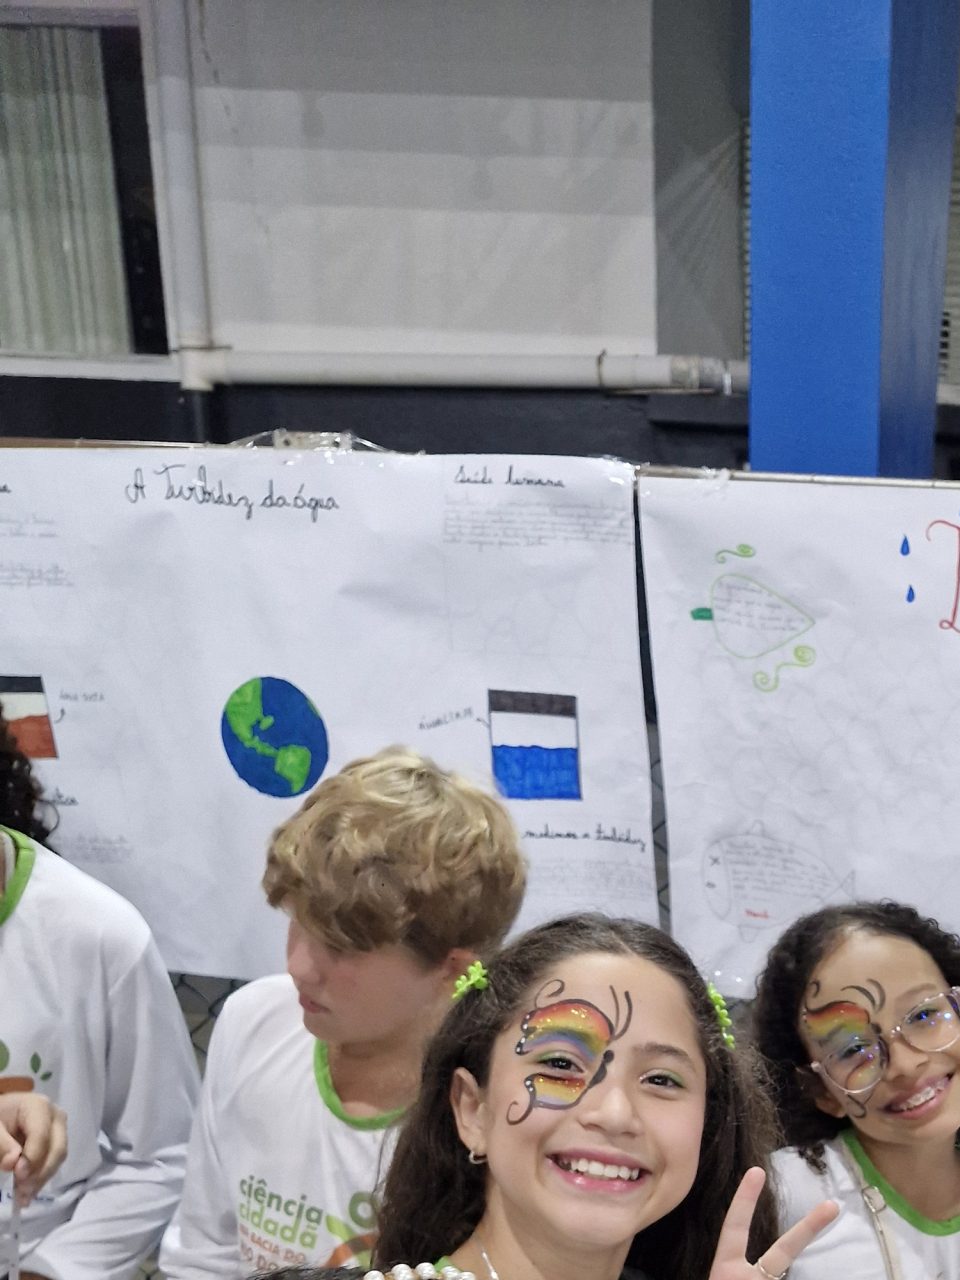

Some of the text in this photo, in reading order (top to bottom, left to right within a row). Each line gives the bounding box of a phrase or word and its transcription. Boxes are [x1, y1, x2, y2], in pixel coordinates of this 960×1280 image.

[125, 467, 145, 503] A
[153, 463, 252, 520] Turbidez
[240, 1174, 324, 1226] ciência
